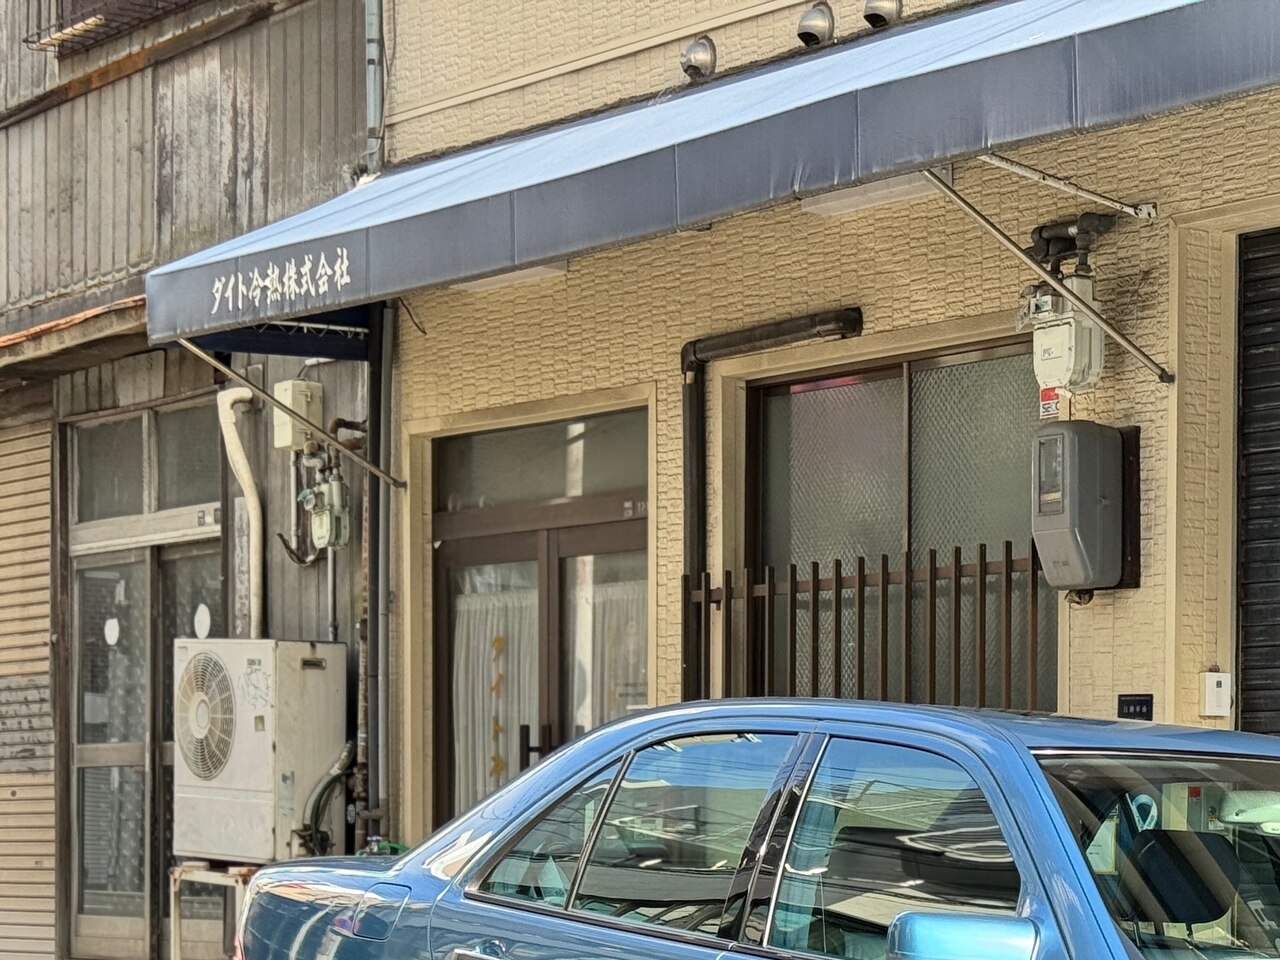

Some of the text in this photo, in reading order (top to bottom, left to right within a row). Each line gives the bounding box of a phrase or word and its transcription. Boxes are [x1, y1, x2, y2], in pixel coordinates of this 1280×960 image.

[211, 247, 351, 315] ダイト冷熱株式会社
